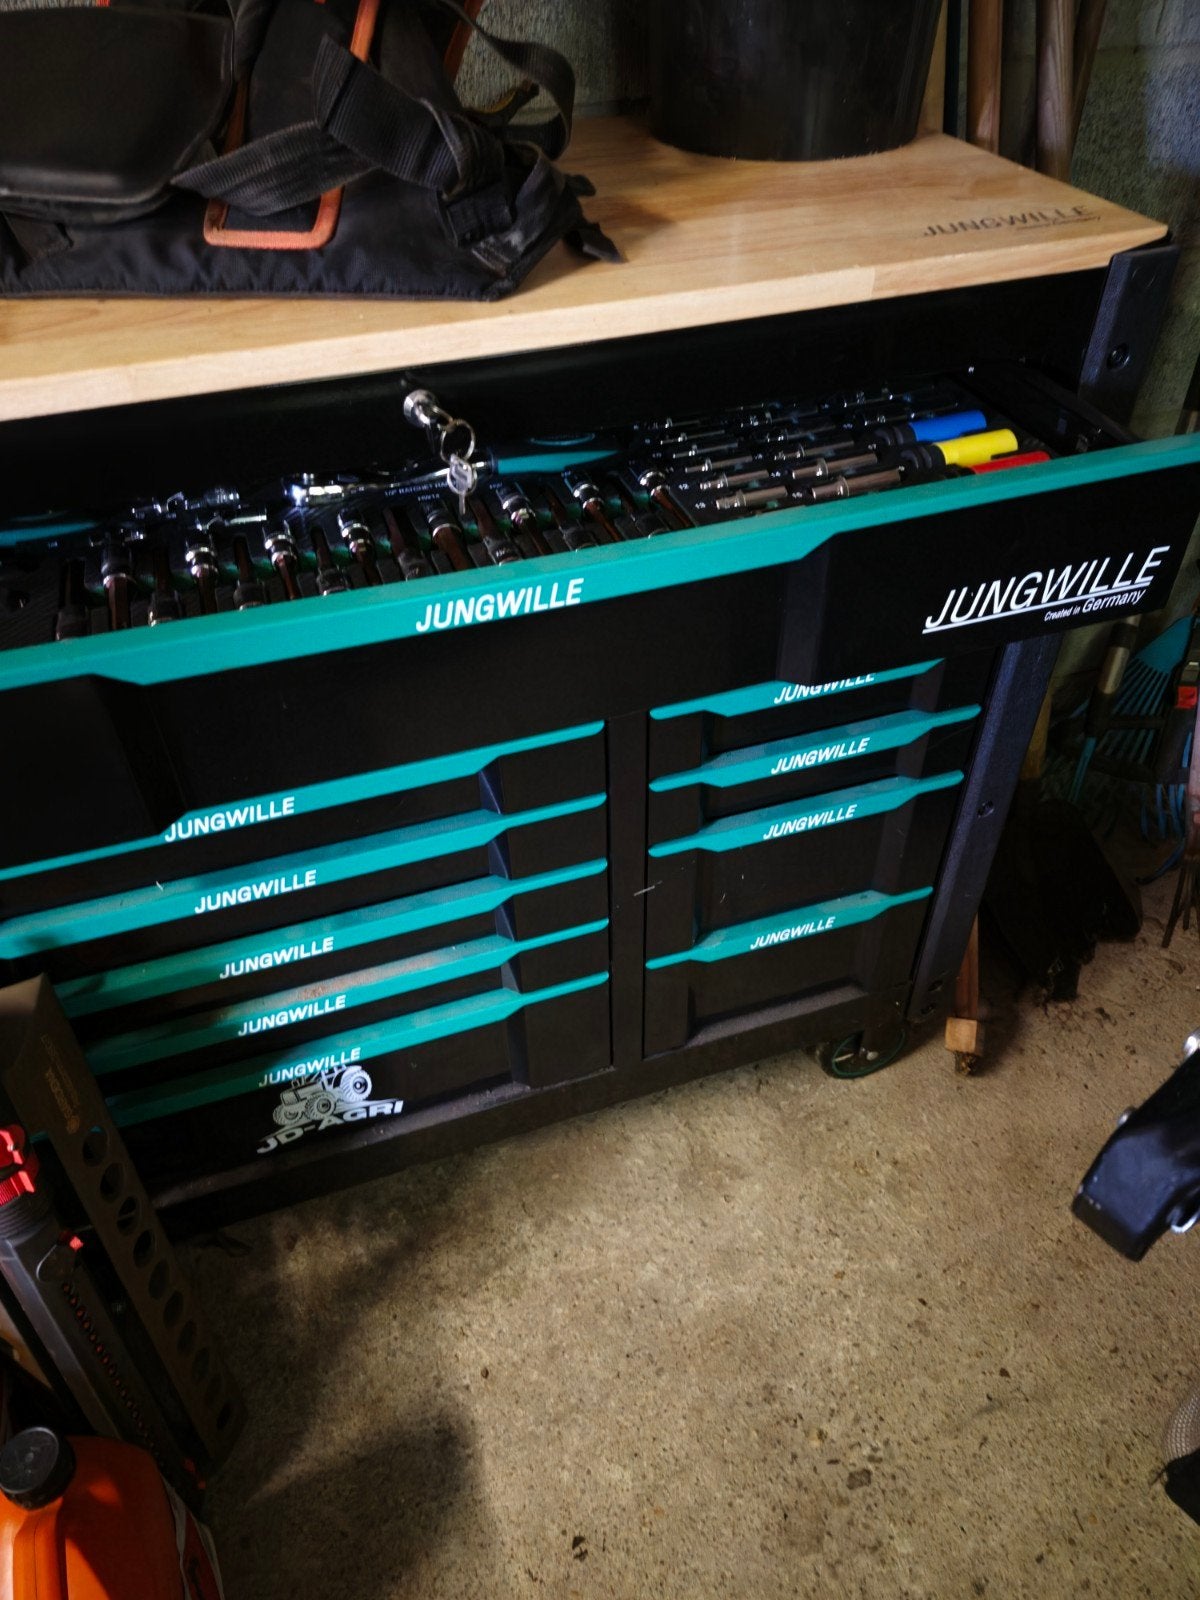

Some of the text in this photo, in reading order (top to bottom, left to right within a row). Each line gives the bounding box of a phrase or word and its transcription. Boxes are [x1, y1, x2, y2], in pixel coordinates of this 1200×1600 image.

[923, 205, 1090, 237] JUNGWILLE
[415, 577, 584, 633] JUNGWILLE
[924, 545, 1171, 629] JUNGWILLE
[1044, 589, 1146, 622] Created in Germany
[771, 737, 870, 775] JUNGWILLE
[164, 796, 295, 842] JUNGWILLE
[763, 804, 857, 840] JUNGWILLE
[194, 869, 317, 915] JUNGWILLE
[750, 916, 835, 950] JUNGWILLE
[219, 936, 335, 979] JUNGWILLE
[238, 995, 347, 1036] JUNGWILLE
[258, 1047, 362, 1087] JUNGWILLE
[256, 1100, 404, 1154] JD-AGRI
